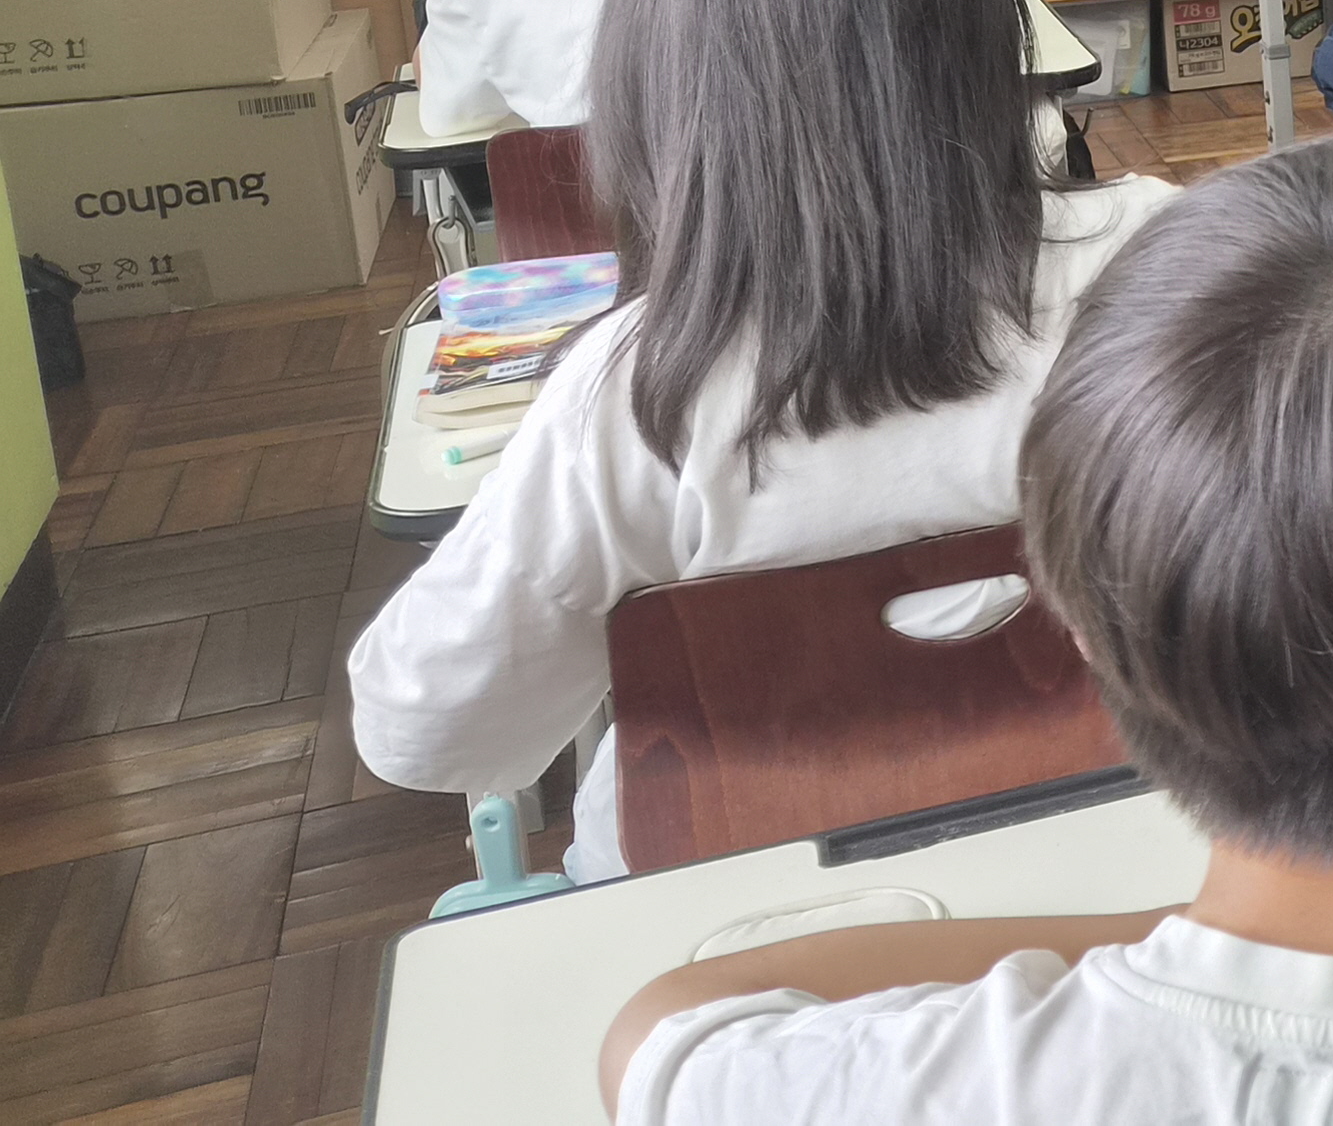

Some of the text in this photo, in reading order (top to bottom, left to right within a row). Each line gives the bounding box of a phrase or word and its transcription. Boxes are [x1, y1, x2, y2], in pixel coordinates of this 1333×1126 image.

[1178, 3, 1216, 18] 78 g
[74, 172, 269, 220] coupang
